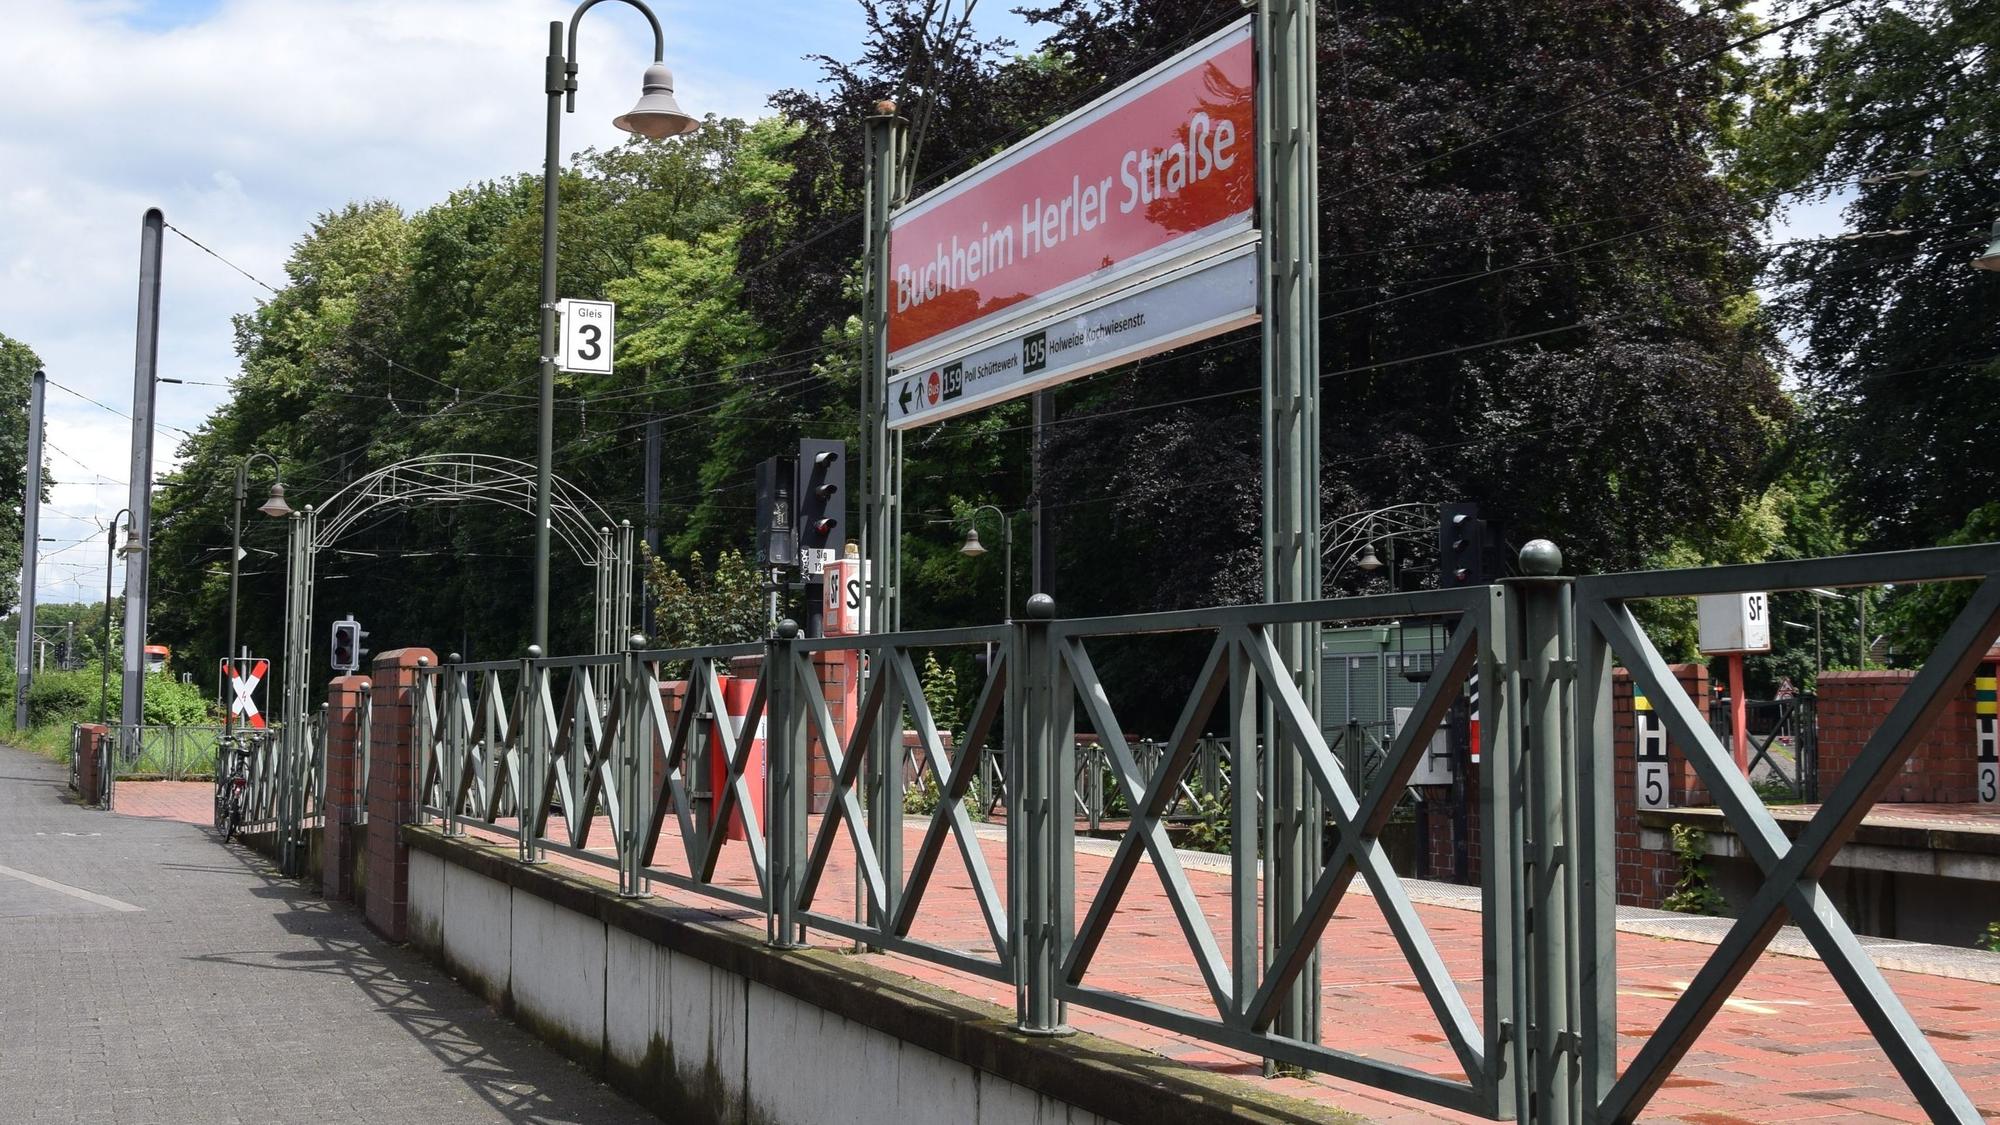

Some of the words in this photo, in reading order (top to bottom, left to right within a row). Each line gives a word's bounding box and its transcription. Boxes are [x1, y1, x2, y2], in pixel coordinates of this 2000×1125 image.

[897, 221, 1014, 314] Buchheim
[1022, 175, 1112, 259] Herler
[1120, 112, 1235, 214] Straße
[578, 307, 603, 319] Gleis
[577, 324, 602, 361] 3
[928, 383, 940, 397] Bus
[943, 368, 961, 394] 159
[964, 368, 977, 383] Poll
[977, 354, 1018, 379] Schüttewerk
[1024, 338, 1045, 367] 195
[1049, 332, 1085, 355] Holweide
[1086, 313, 1146, 343] Kochwiesenstr.
[1749, 596, 1763, 621] SF
[1637, 714, 1667, 756] H
[1976, 718, 1998, 757] H
[1645, 768, 1663, 806] 5
[1981, 768, 1997, 803] 3
